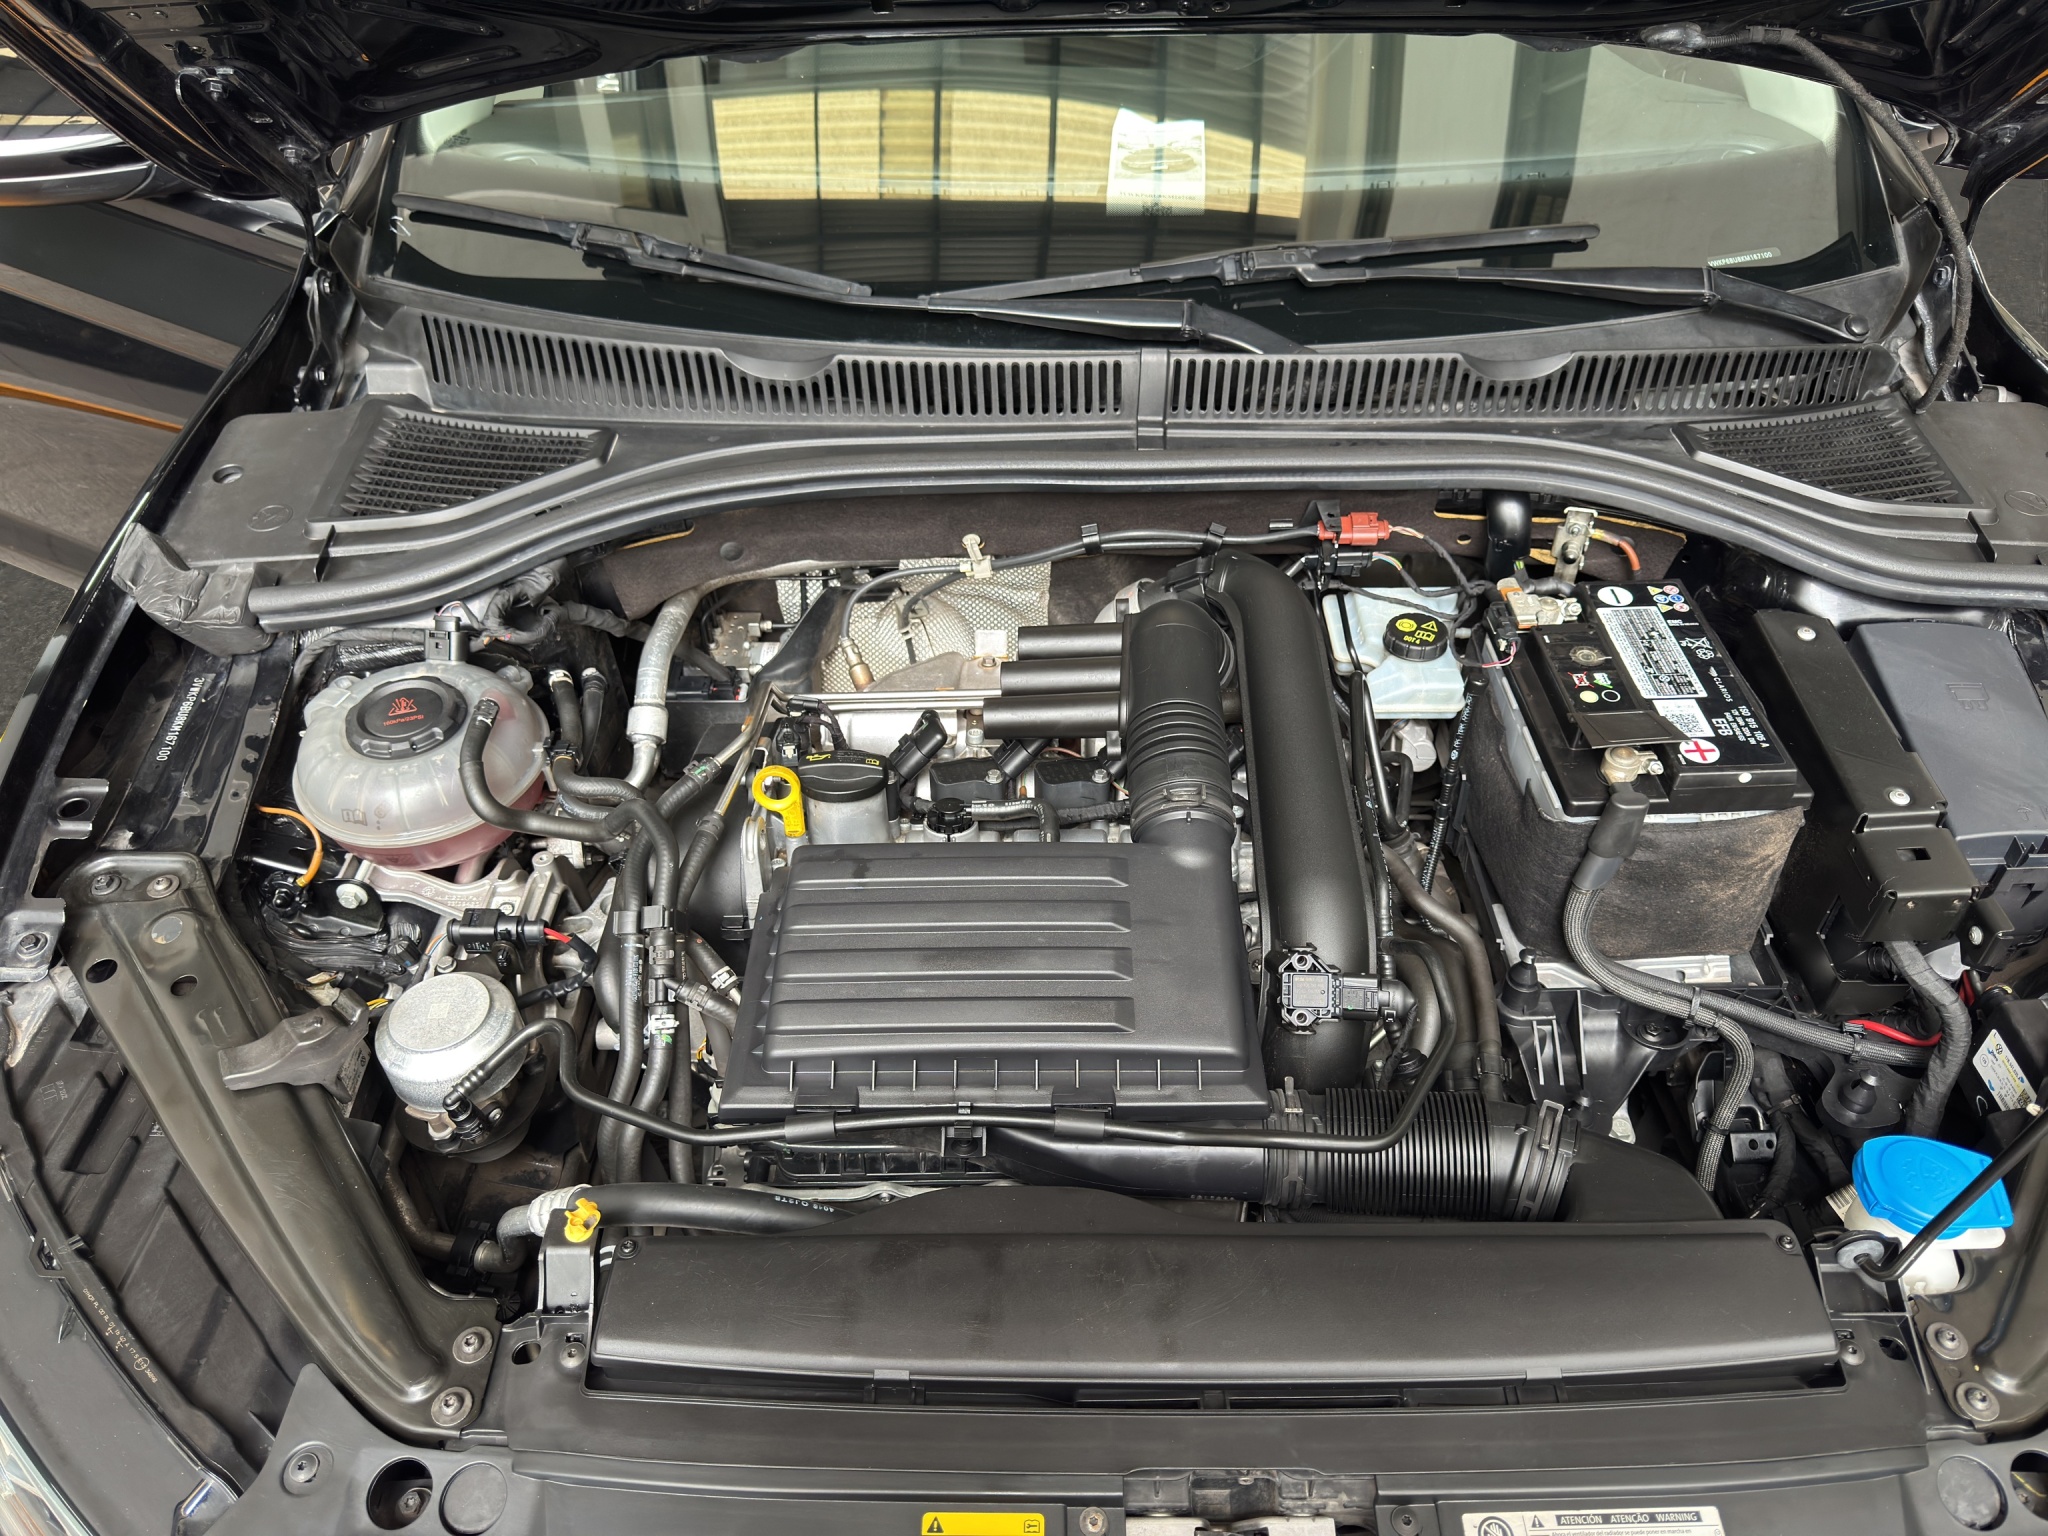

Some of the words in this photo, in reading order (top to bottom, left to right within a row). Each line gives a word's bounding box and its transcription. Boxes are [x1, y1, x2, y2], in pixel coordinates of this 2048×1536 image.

[1403, 634, 1416, 643] DOT
[1713, 677, 1733, 703] CLARIOS
[1711, 718, 1734, 736] EFB
[1745, 717, 1758, 729] 915
[1753, 730, 1766, 742] 105
[1560, 1513, 1603, 1525] ATENCIÓN
[1610, 1512, 1650, 1524] ATENÇÃO
[1655, 1512, 1698, 1522] WARNING
